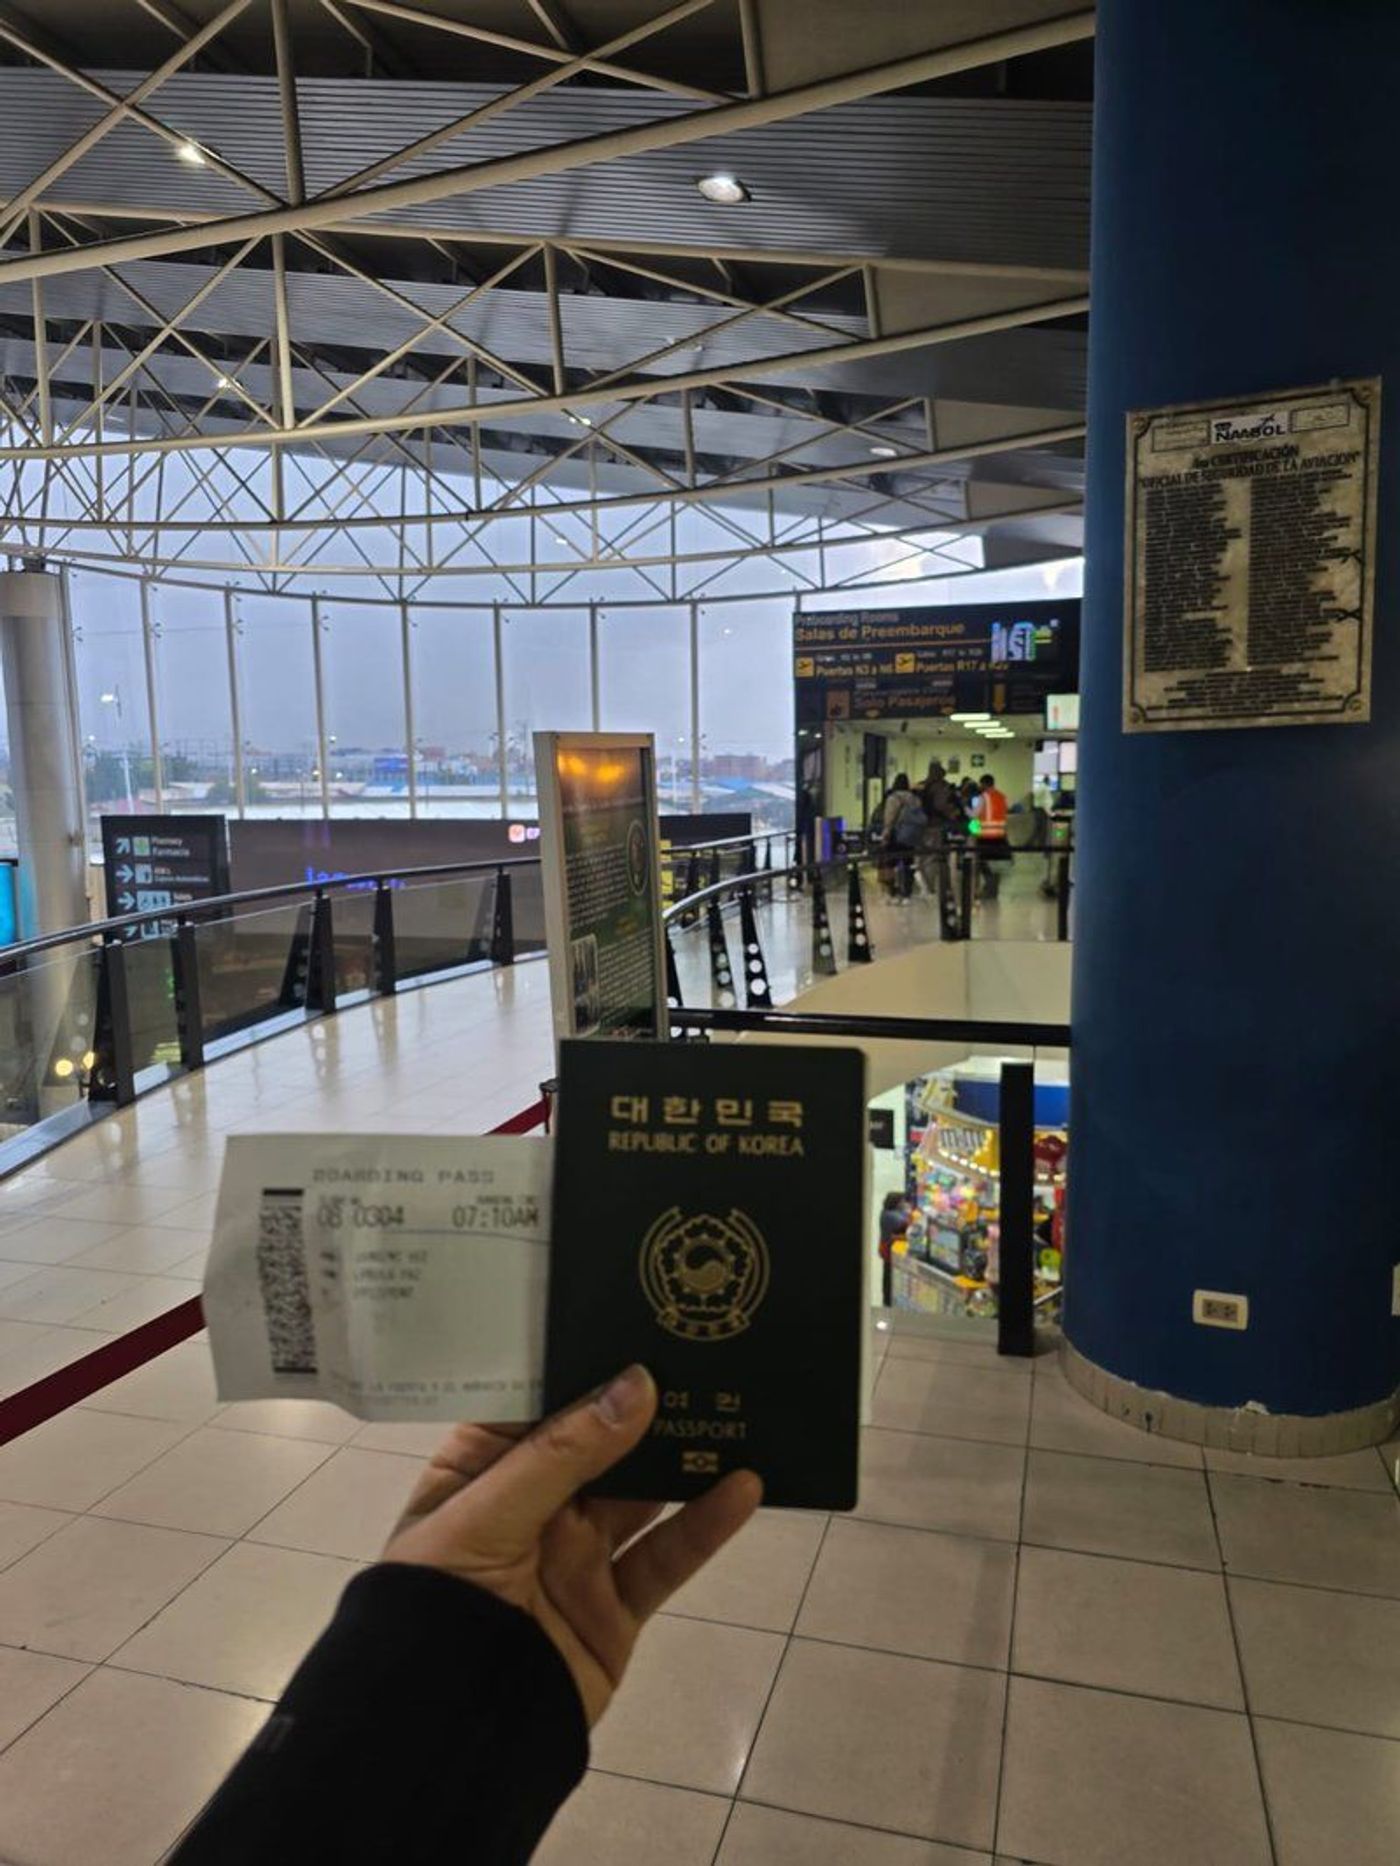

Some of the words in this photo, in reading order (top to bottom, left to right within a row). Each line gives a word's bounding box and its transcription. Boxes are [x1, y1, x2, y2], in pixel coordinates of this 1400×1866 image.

[798, 627, 835, 641] Salas
[838, 625, 857, 639] de
[861, 622, 965, 640] Preembarque
[608, 1130, 697, 1153] REPUBLIC
[706, 1133, 729, 1154] OF
[739, 1134, 805, 1157] KOREA
[311, 1168, 425, 1184] BOARDING
[437, 1168, 496, 1184] PASS
[452, 1204, 540, 1229] 07:10AM
